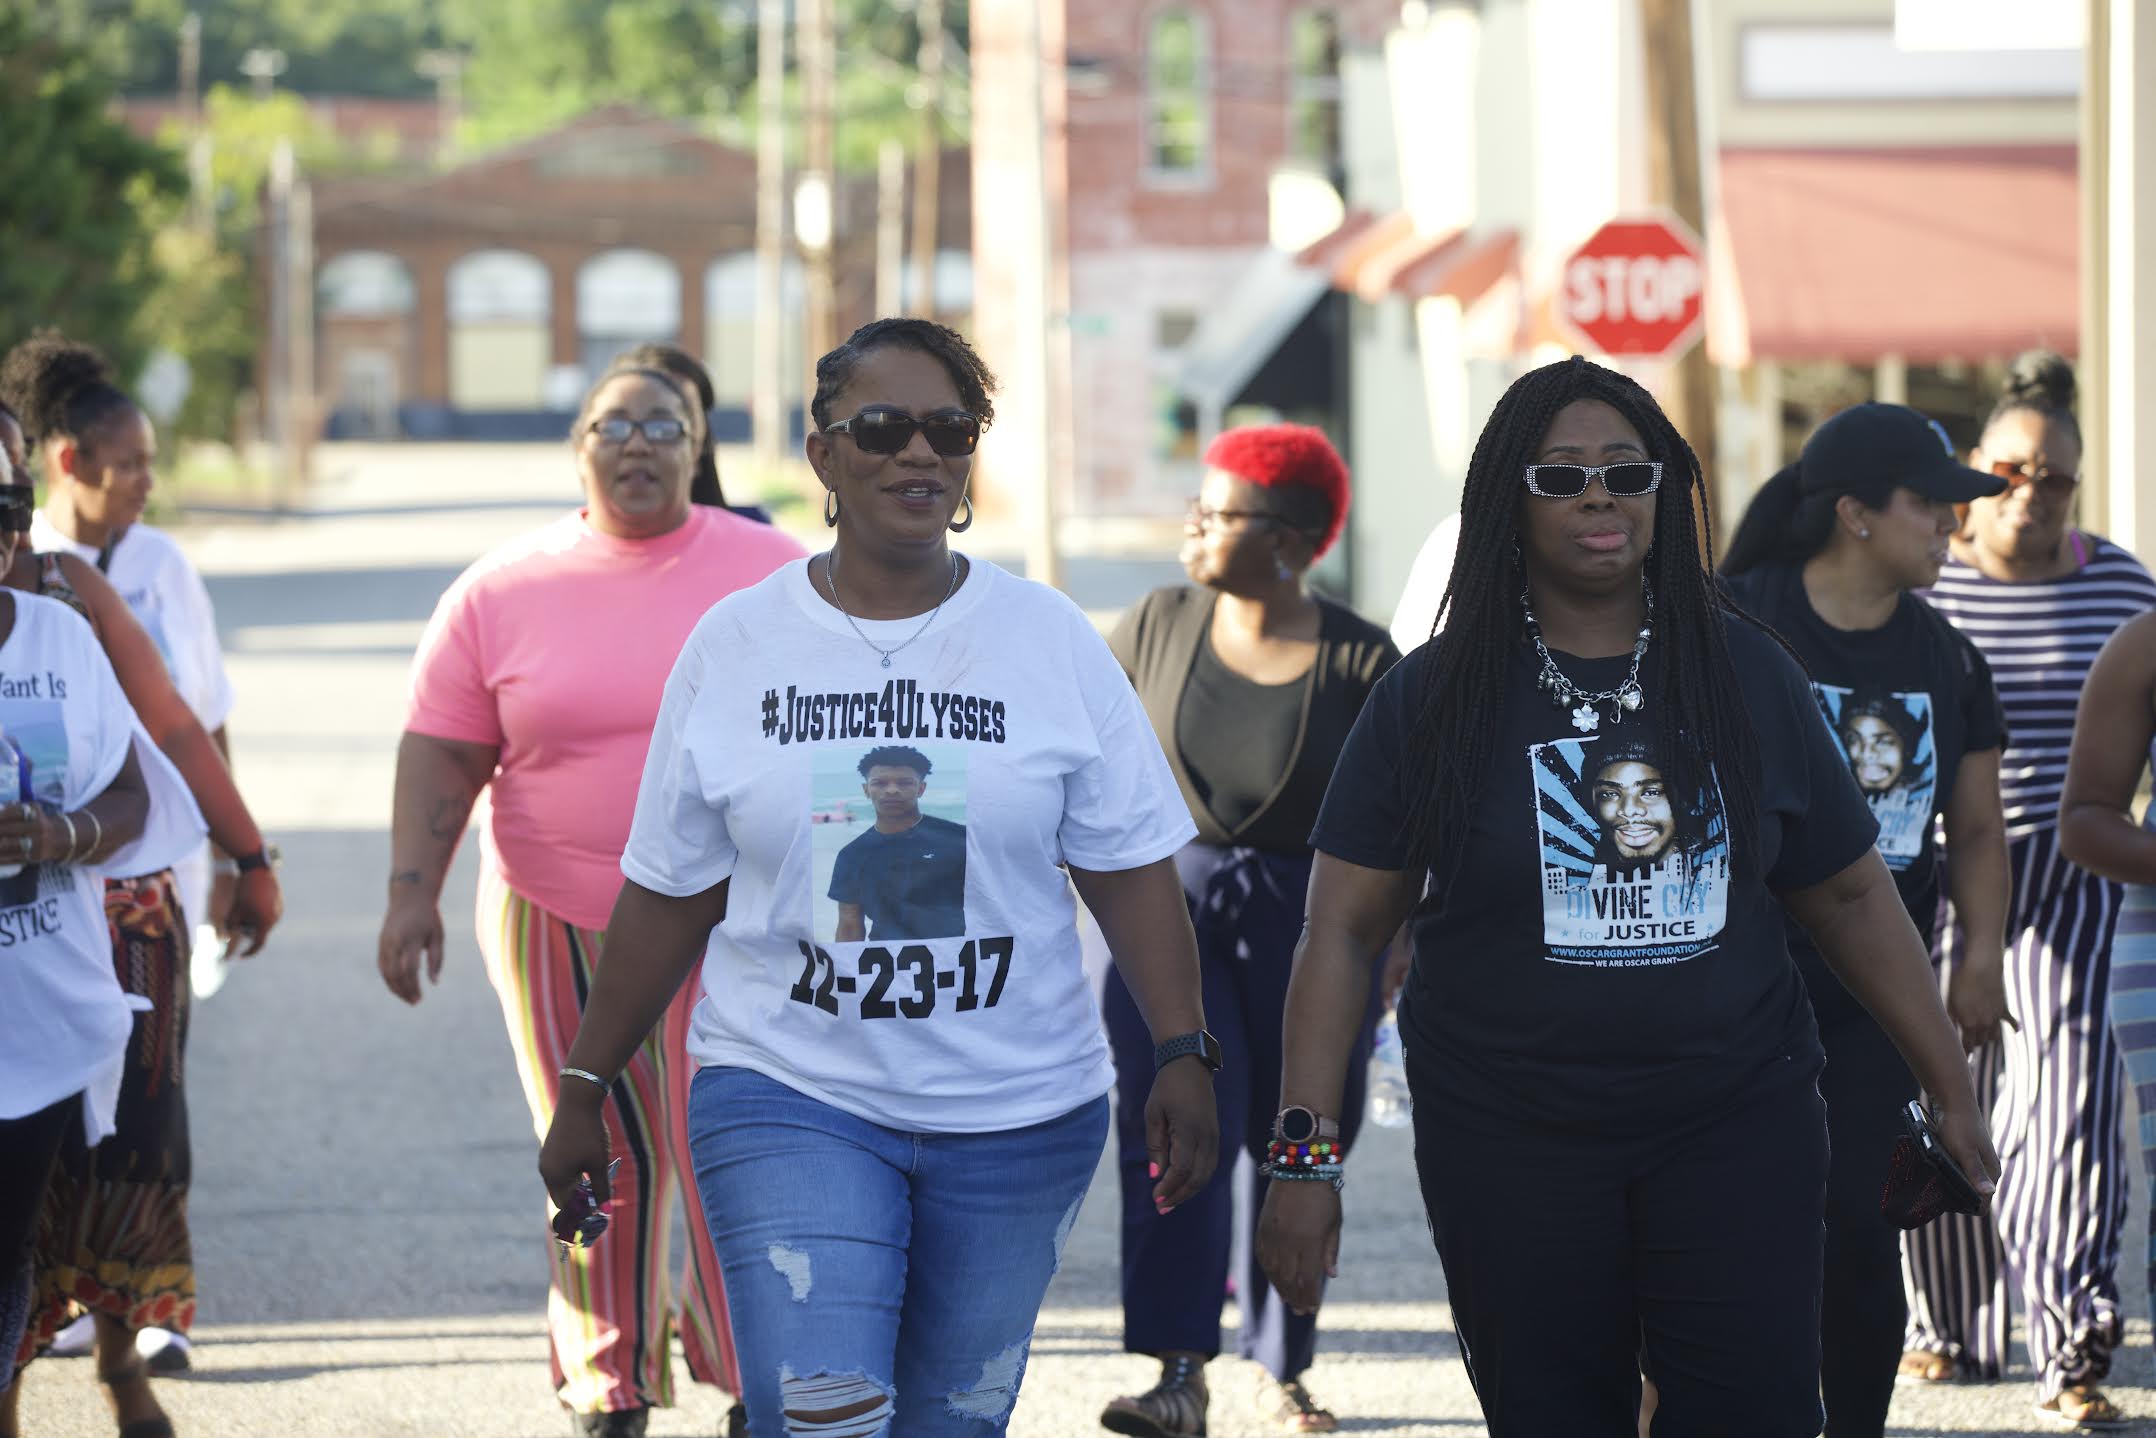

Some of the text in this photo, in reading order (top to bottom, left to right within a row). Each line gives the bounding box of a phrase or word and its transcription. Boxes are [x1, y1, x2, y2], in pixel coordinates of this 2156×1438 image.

[1568, 257, 1699, 321] STOP
[0, 672, 66, 698] ant Is
[762, 679, 1005, 745] #JUSTICE4ULYSSES
[1567, 880, 1710, 920] DIVINE CRY
[1579, 920, 1695, 941] for JUSTICE
[790, 937, 1013, 1019] 12-23-17
[1595, 956, 1677, 968] WE ARE OSCAR GRANT
